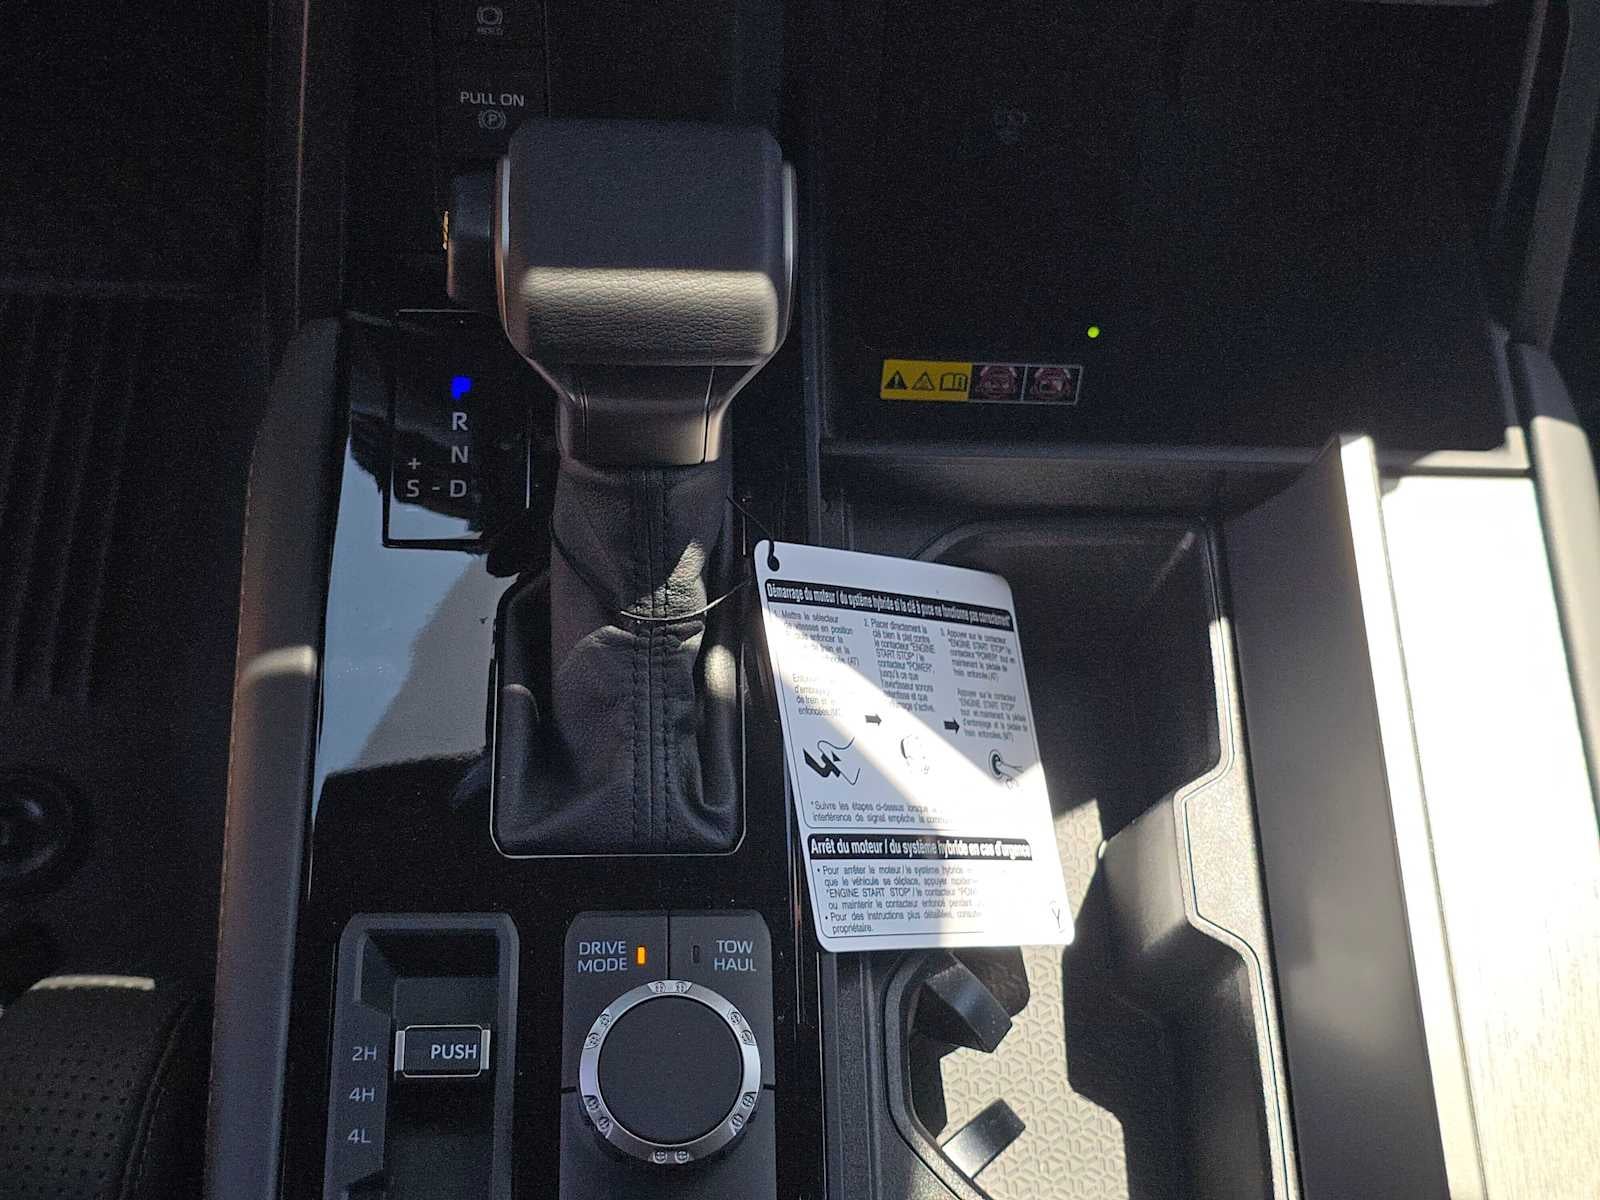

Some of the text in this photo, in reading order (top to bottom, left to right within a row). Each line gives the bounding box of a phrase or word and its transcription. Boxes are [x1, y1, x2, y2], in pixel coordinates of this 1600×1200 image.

[460, 91, 526, 107] PULL ON
[450, 374, 472, 400] P
[451, 411, 469, 431] R
[450, 445, 469, 464] N
[406, 479, 420, 498] S
[448, 479, 468, 498] D
[766, 583, 804, 602] Démarrage
[804, 586, 814, 601] du
[813, 588, 836, 603] moteur
[840, 590, 848, 605] du
[848, 592, 872, 608] système
[872, 594, 894, 611] hybride
[812, 812, 852, 823] interférence
[855, 812, 865, 822] de
[811, 838, 835, 855] Arrêt
[837, 838, 850, 855] du
[851, 839, 883, 855] moteur
[889, 838, 902, 855] du
[903, 839, 937, 858] système
[937, 839, 968, 859] hybride
[968, 842, 980, 856] en
[980, 842, 994, 857] cas
[994, 840, 1032, 860] d'urgence
[822, 865, 839, 875] Pour
[844, 865, 866, 875] arrêter
[824, 878, 839, 888] que
[852, 876, 880, 887] véhicule
[862, 887, 885, 898] START
[828, 902, 838, 911] ou
[841, 901, 873, 910] maintenir
[830, 912, 847, 921] Pour
[851, 911, 865, 920] des
[867, 911, 905, 920] instructions
[578, 940, 628, 955] DRIVE
[716, 939, 754, 954] TOW
[577, 957, 628, 973] MODE
[714, 957, 757, 972] HAUL
[352, 1045, 377, 1061] 2H
[430, 1043, 478, 1060] PUSH
[348, 1086, 376, 1102] 4H
[347, 1128, 372, 1144] 4L
